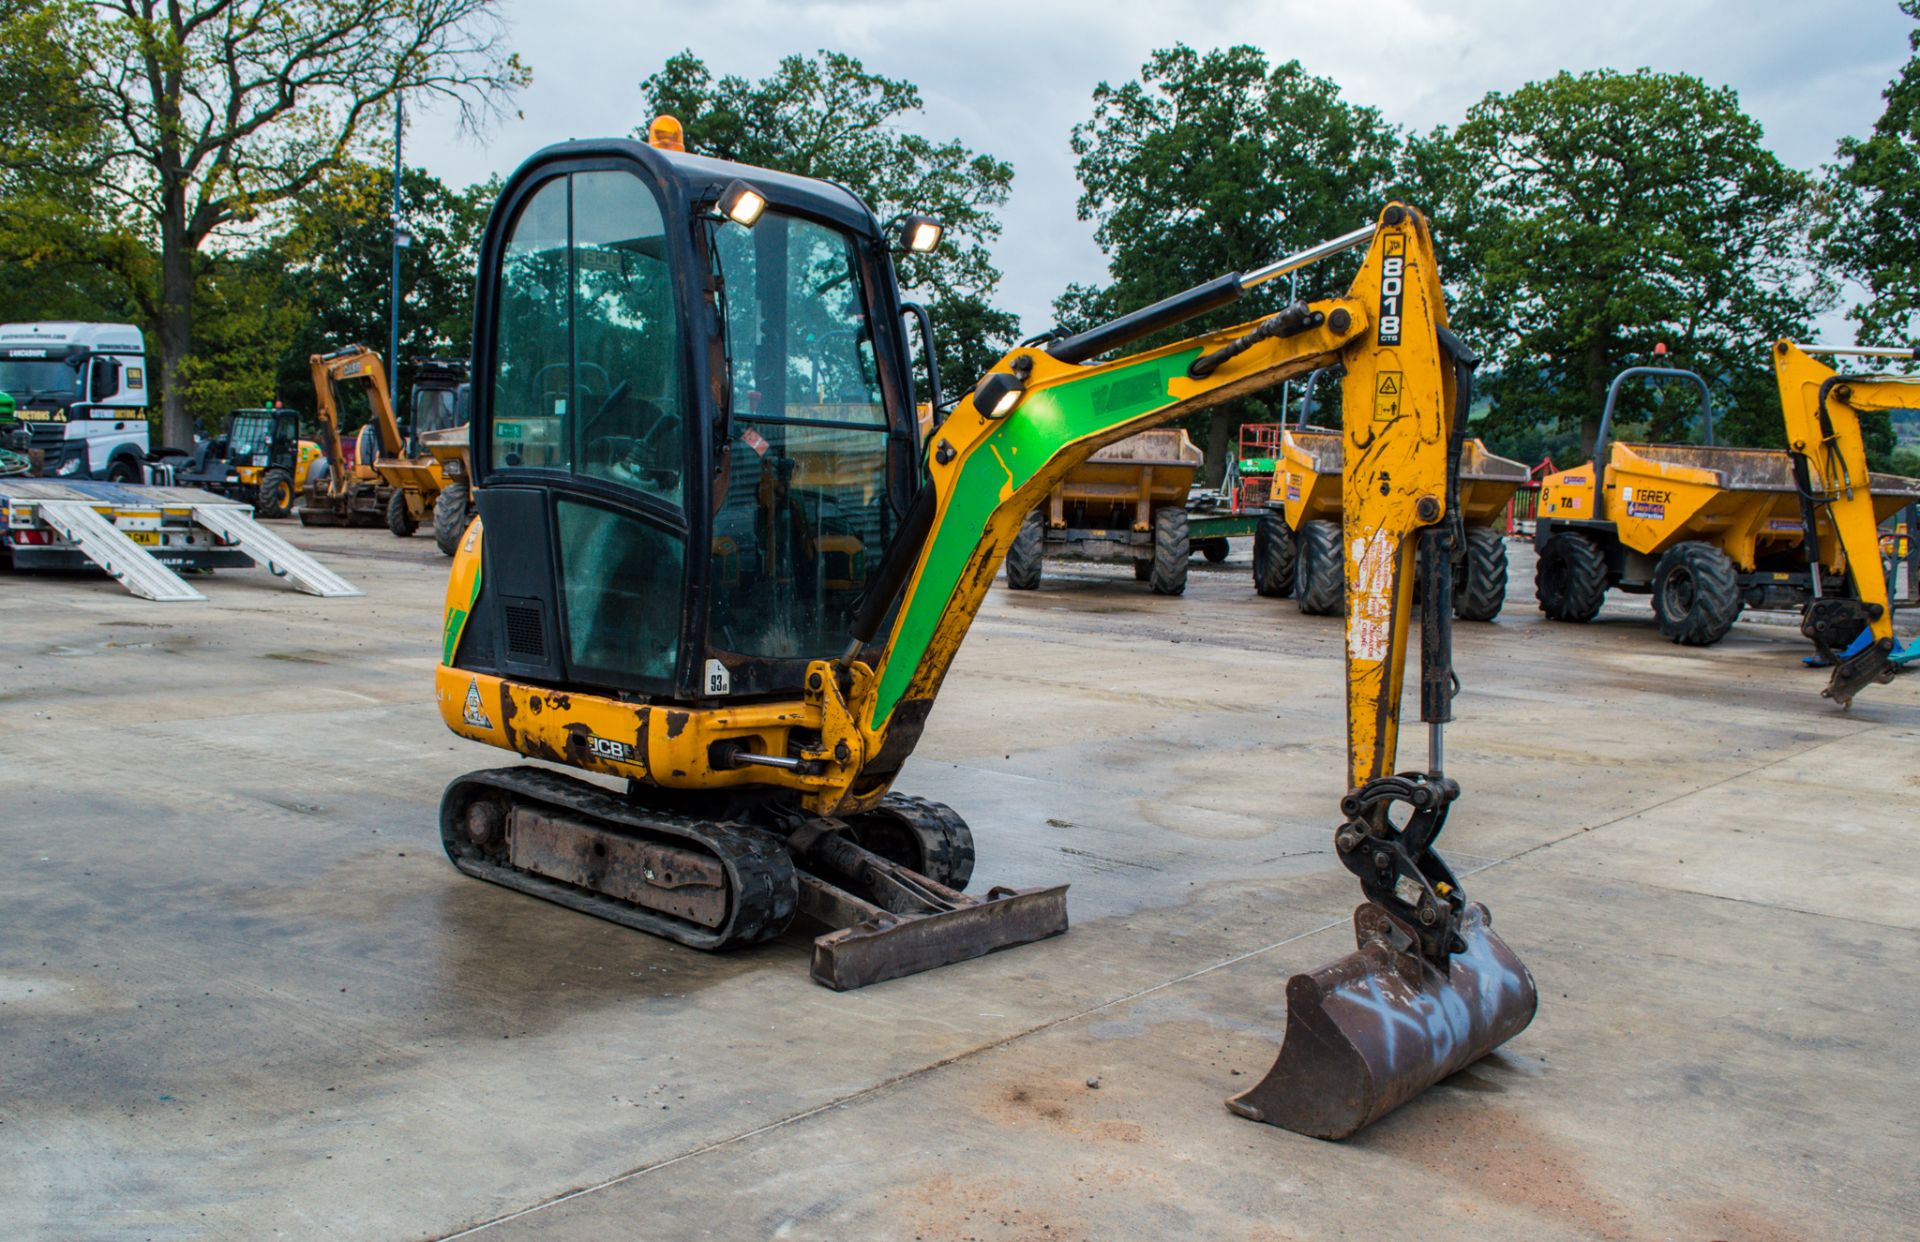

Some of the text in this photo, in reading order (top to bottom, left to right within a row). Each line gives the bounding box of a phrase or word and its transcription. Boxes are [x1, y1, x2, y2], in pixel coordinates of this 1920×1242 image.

[1380, 257, 1403, 335] 8018
[1542, 488, 1550, 501] 8
[1636, 489, 1671, 504] TEREX
[711, 674, 722, 692] 93
[591, 738, 624, 757] JCB
